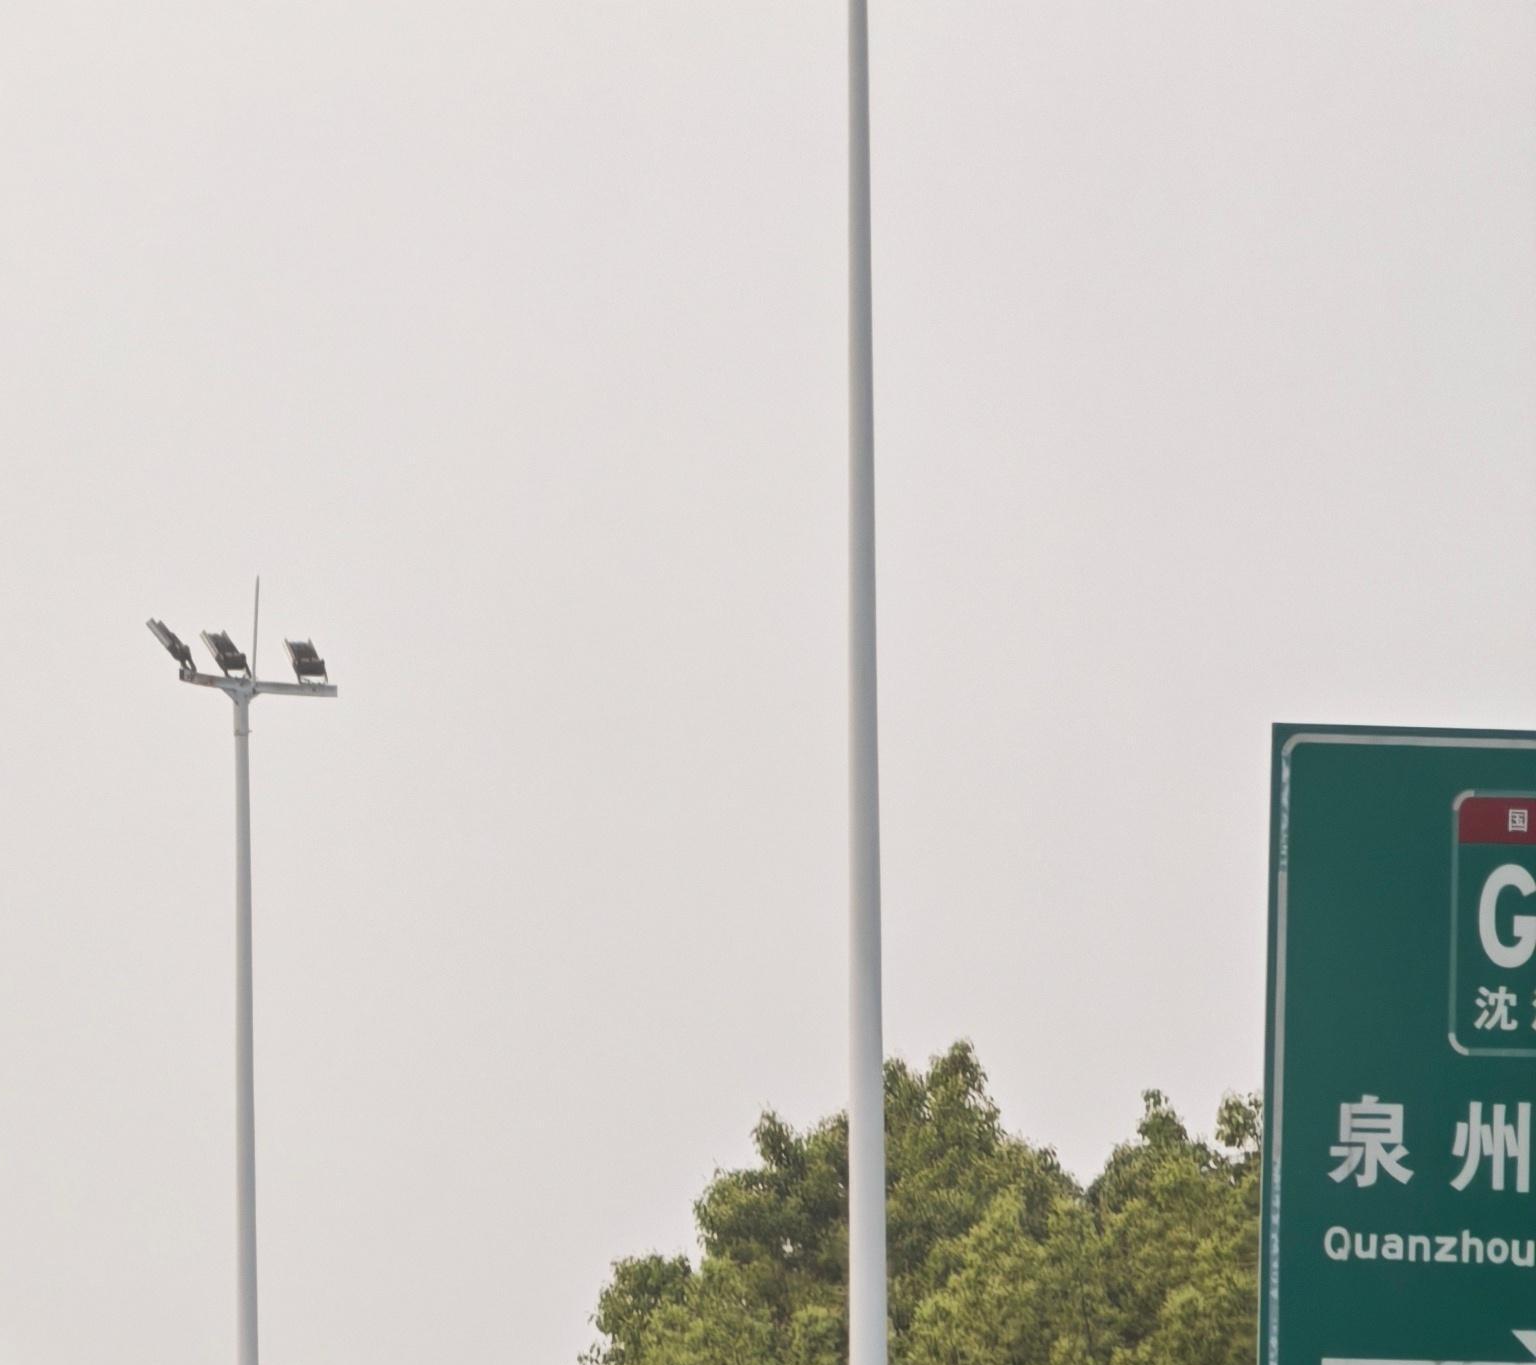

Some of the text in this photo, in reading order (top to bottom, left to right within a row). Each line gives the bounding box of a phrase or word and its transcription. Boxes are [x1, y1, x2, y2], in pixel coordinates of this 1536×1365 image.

[1478, 863, 1536, 969] G
[1473, 985, 1536, 1031] 沈
[1327, 1093, 1532, 1193] 泉州
[1323, 1225, 1536, 1267] Quanzhou
